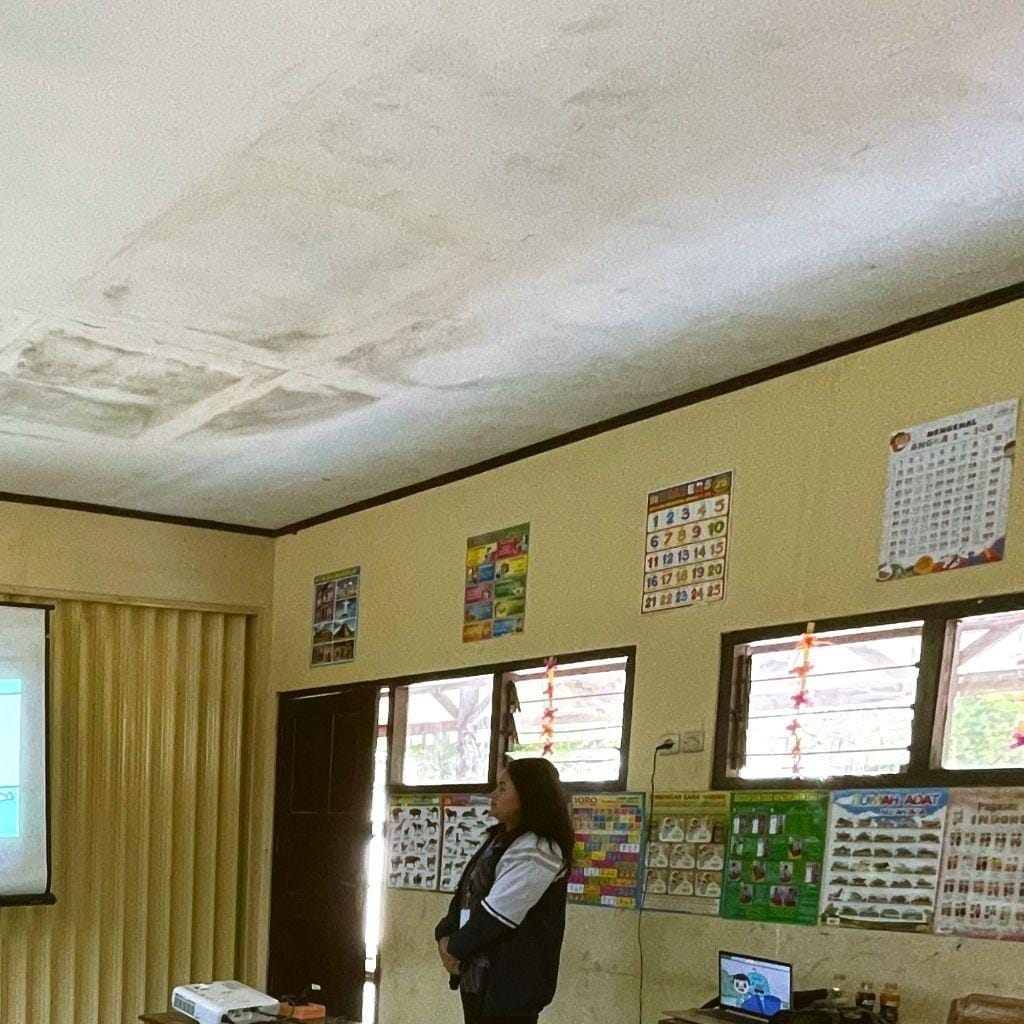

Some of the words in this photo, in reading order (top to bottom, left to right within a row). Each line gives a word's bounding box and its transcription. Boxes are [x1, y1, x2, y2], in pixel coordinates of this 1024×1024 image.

[653, 515, 658, 528] 1
[666, 512, 674, 524] 2
[681, 508, 690, 519] 3
[698, 504, 706, 517] 4
[714, 499, 724, 512] 5
[650, 536, 658, 548] 6
[664, 532, 672, 545] 7
[678, 528, 686, 542] 8
[692, 526, 701, 538] 9
[708, 521, 724, 535] 10
[648, 556, 658, 568] 11
[663, 553, 673, 565] 12
[678, 550, 689, 562] 13
[694, 546, 706, 558] 14
[710, 542, 724, 555] 15
[647, 576, 658, 588] 16
[662, 573, 672, 584] 17
[692, 566, 704, 578] 19
[708, 564, 722, 576] 20
[645, 596, 656, 608] 21
[676, 590, 688, 603] 23
[691, 587, 703, 600] 24
[707, 584, 720, 597] 25
[905, 793, 942, 806] ADAT
